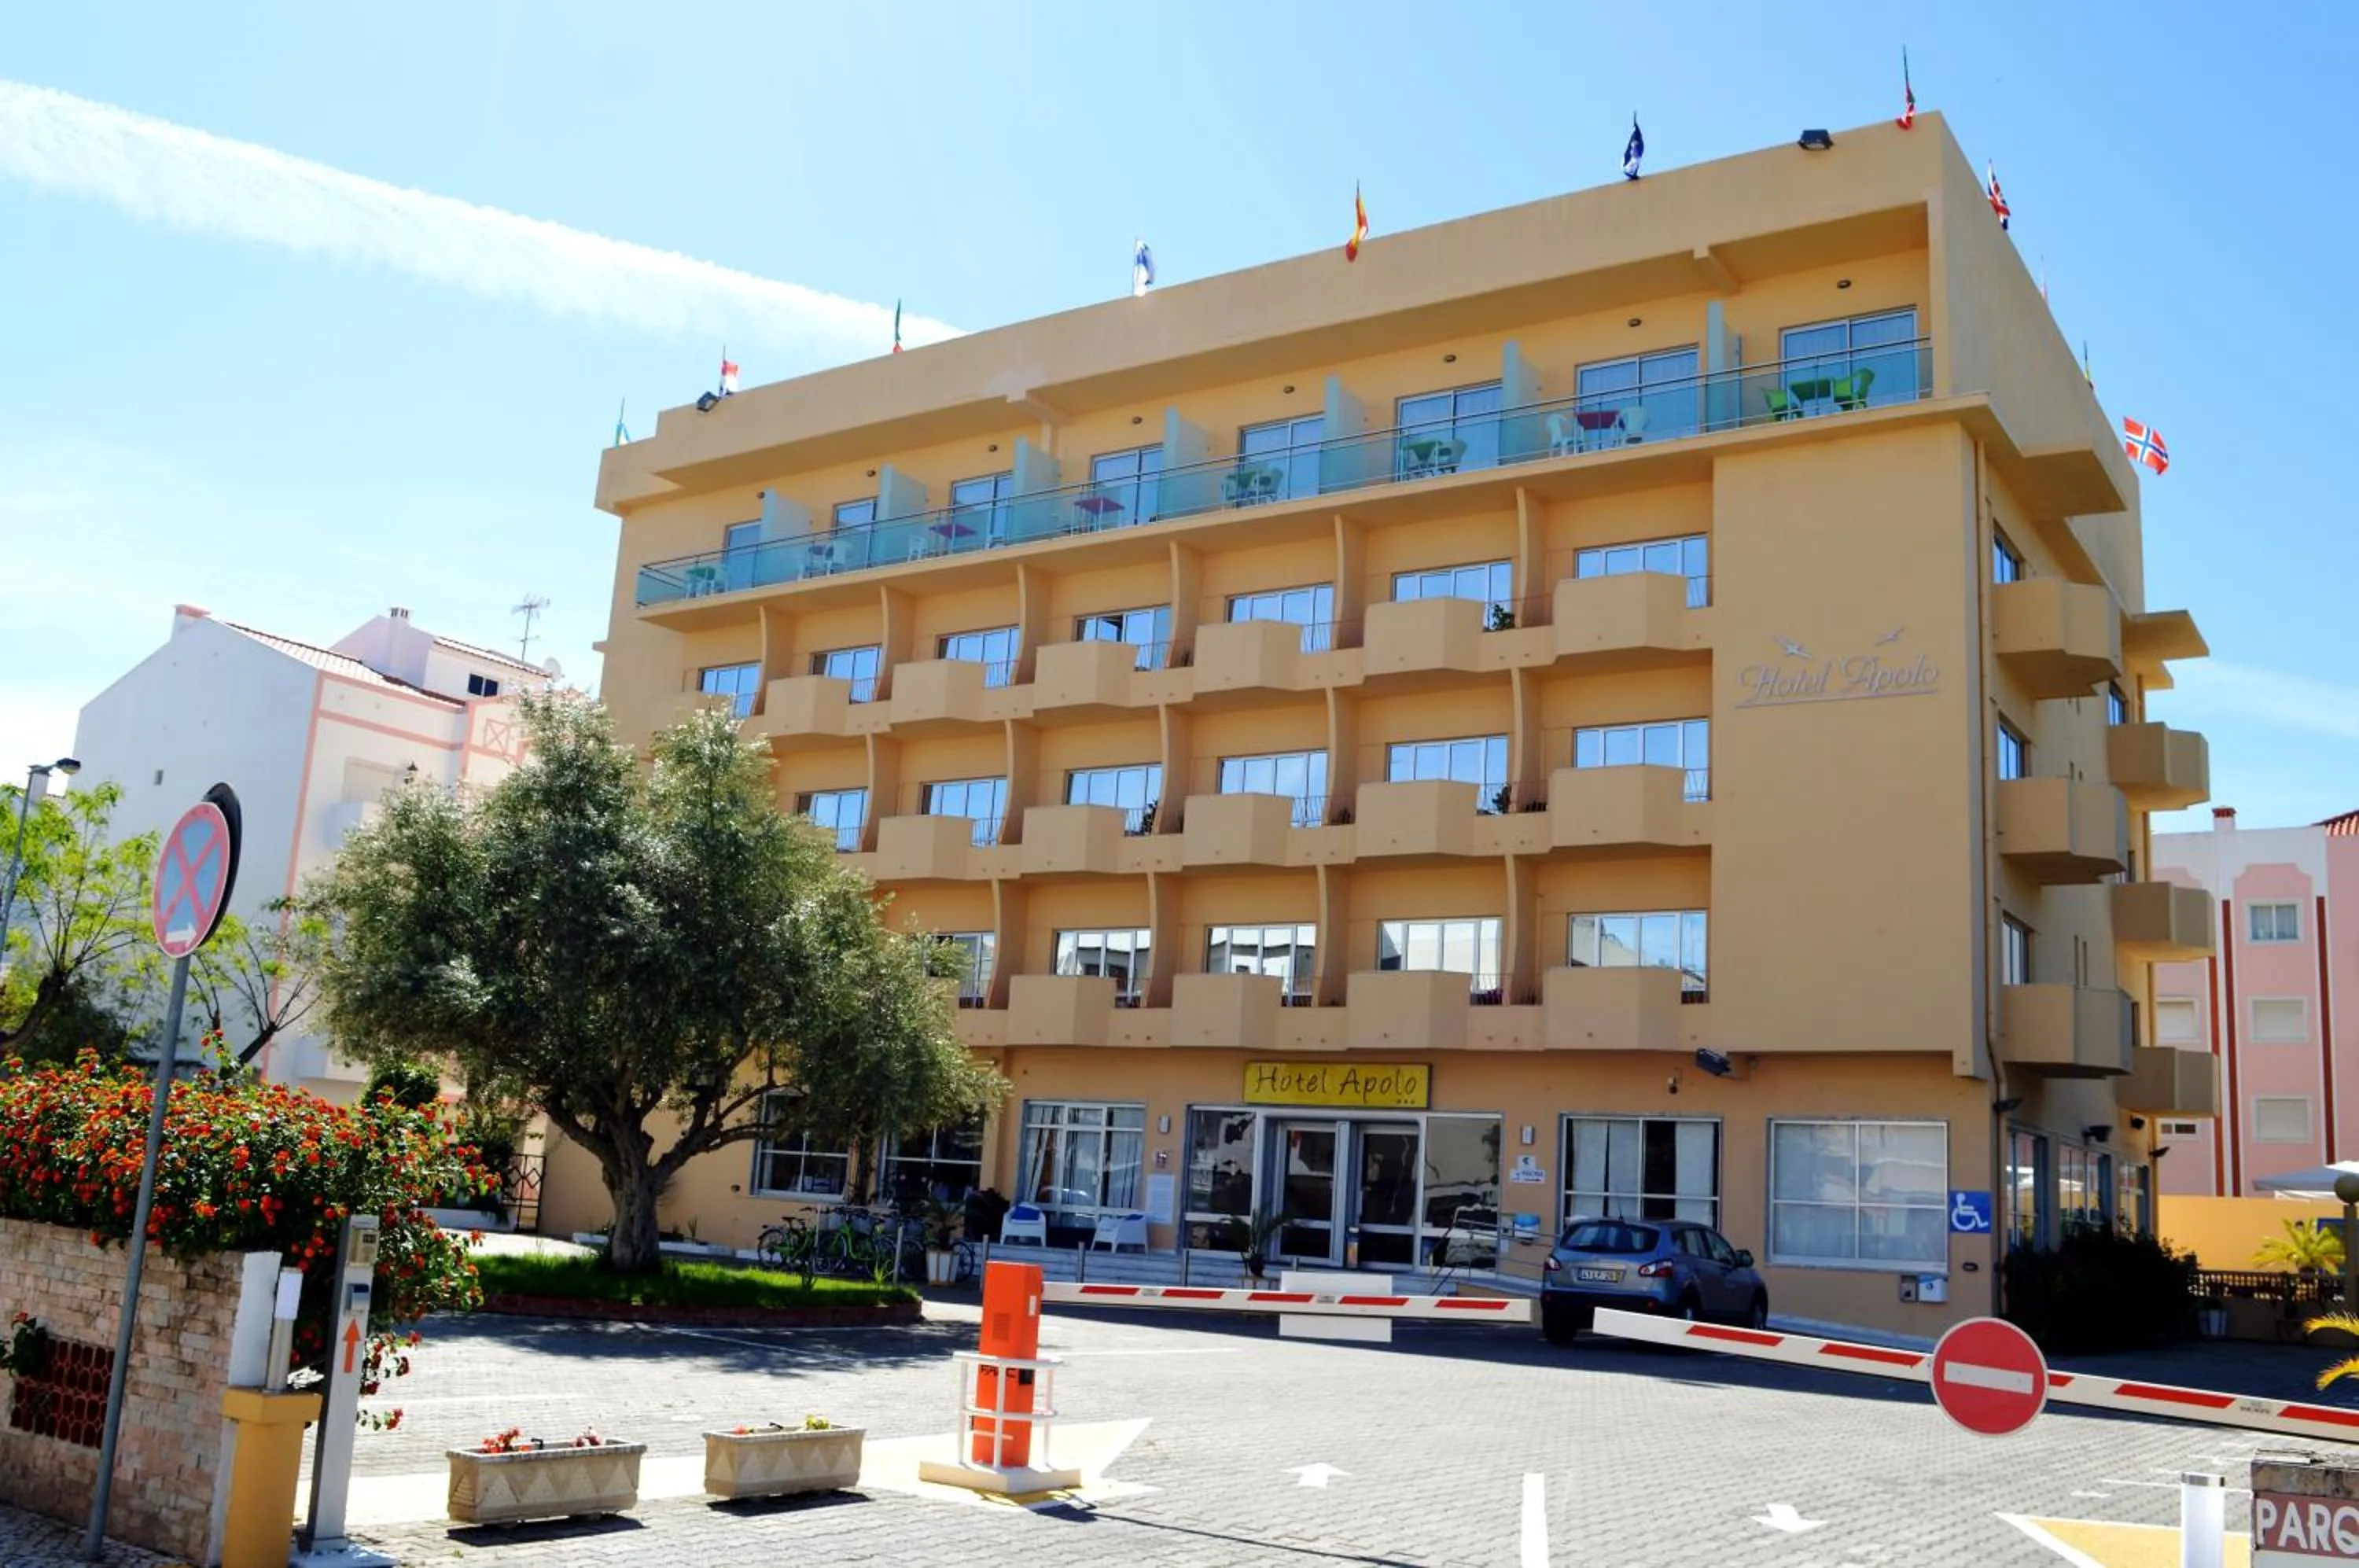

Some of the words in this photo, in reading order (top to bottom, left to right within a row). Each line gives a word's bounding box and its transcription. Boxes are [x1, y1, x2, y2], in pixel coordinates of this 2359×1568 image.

[1737, 660, 1832, 697] Hotel
[1838, 653, 1939, 692] Apolo
[1255, 1066, 1327, 1093] Hotel
[1339, 1068, 1417, 1103] Apolo
